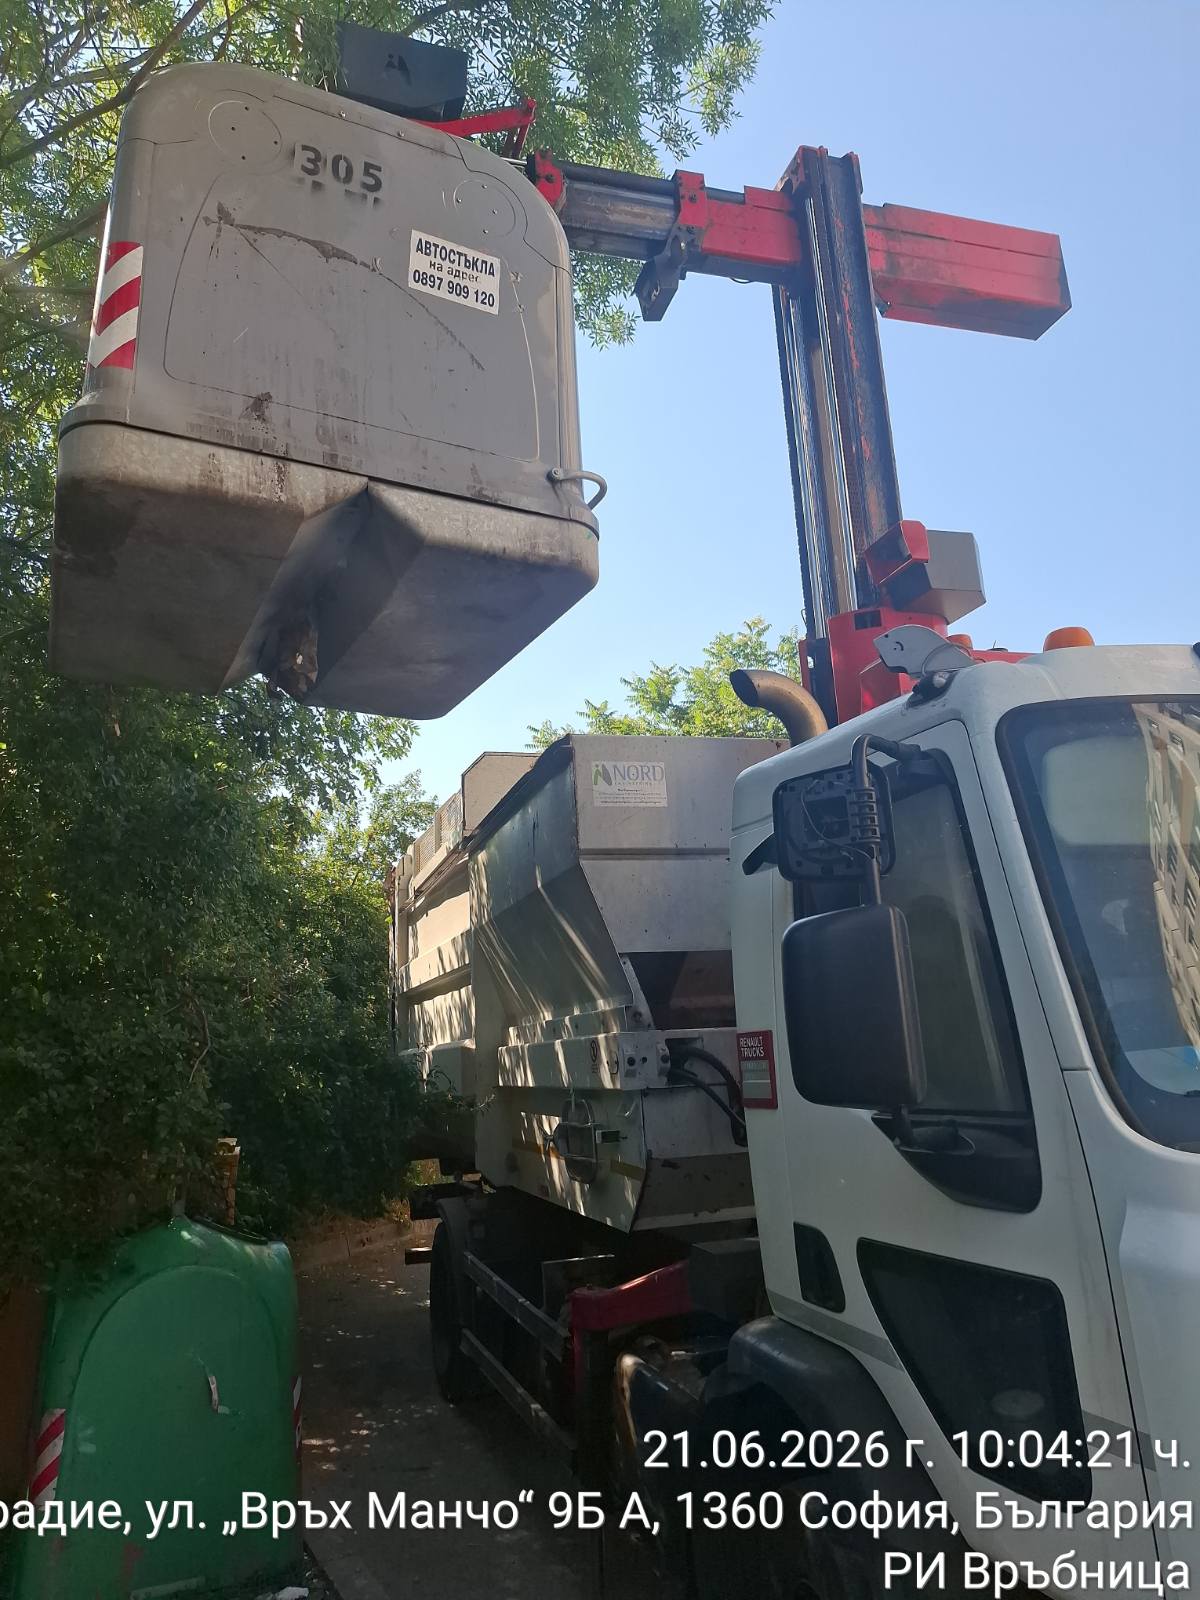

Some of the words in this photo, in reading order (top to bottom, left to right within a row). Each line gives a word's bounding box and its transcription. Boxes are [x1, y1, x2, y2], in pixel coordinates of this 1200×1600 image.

[300, 144, 383, 193] 305
[416, 238, 495, 277] АВТОСТЪКЛА
[429, 260, 443, 272] на
[413, 269, 443, 290] 0897
[447, 280, 469, 299] 909
[474, 289, 495, 307] 120
[612, 764, 665, 781] NORD
[739, 1036, 763, 1047] RENAULT
[740, 1047, 765, 1058] TRUCKS
